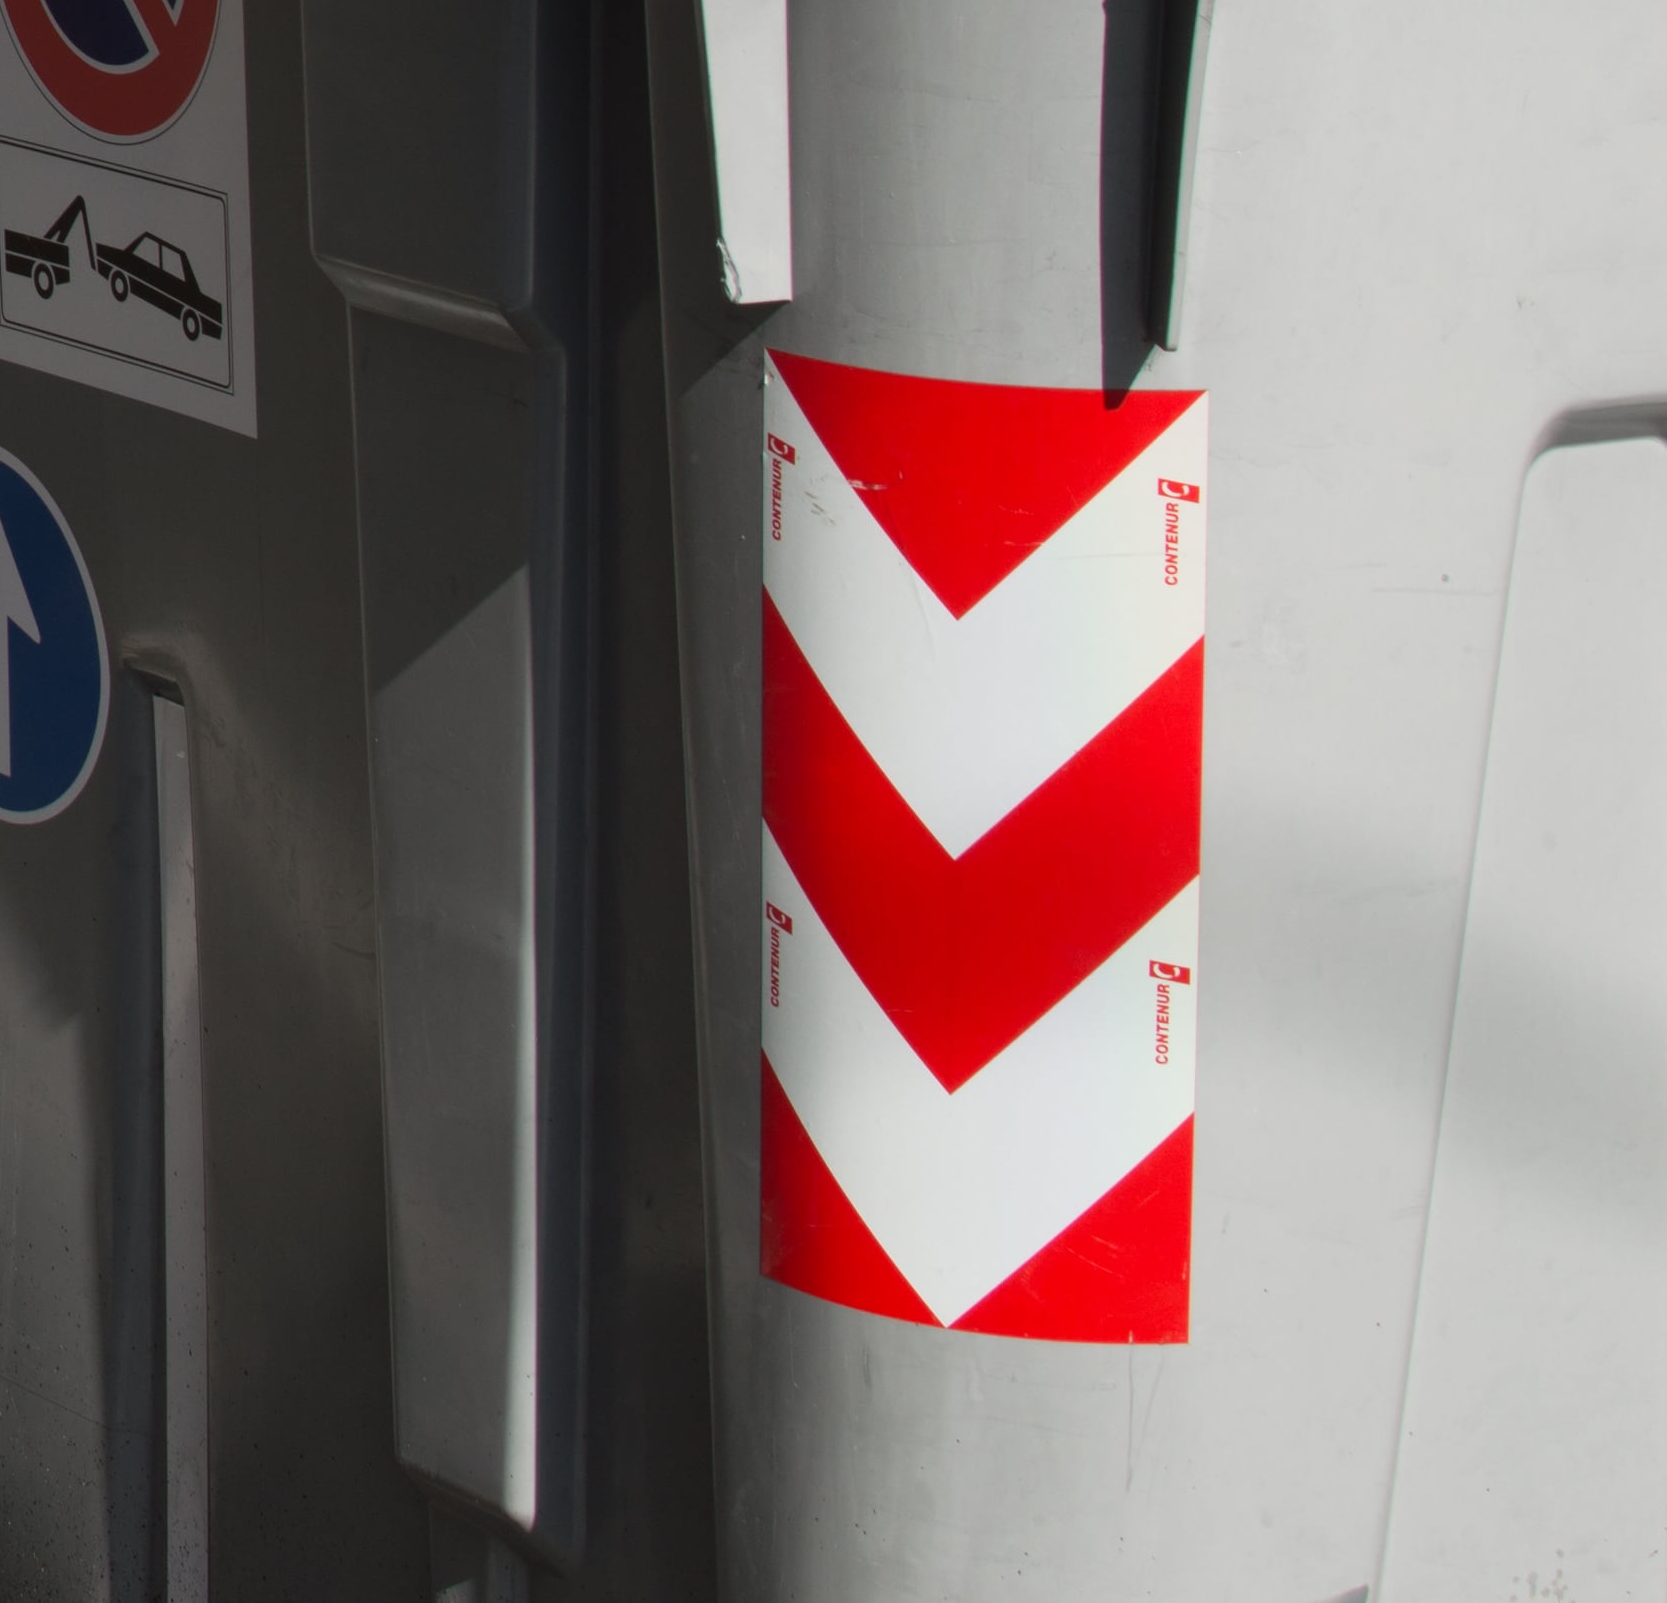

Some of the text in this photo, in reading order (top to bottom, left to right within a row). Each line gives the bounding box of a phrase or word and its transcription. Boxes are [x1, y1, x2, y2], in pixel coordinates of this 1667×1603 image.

[772, 458, 782, 541] CONTENUR
[1164, 502, 1179, 586] CONTENUR
[770, 926, 780, 1007] CONTENUR
[1155, 983, 1170, 1065] CONTENUR
